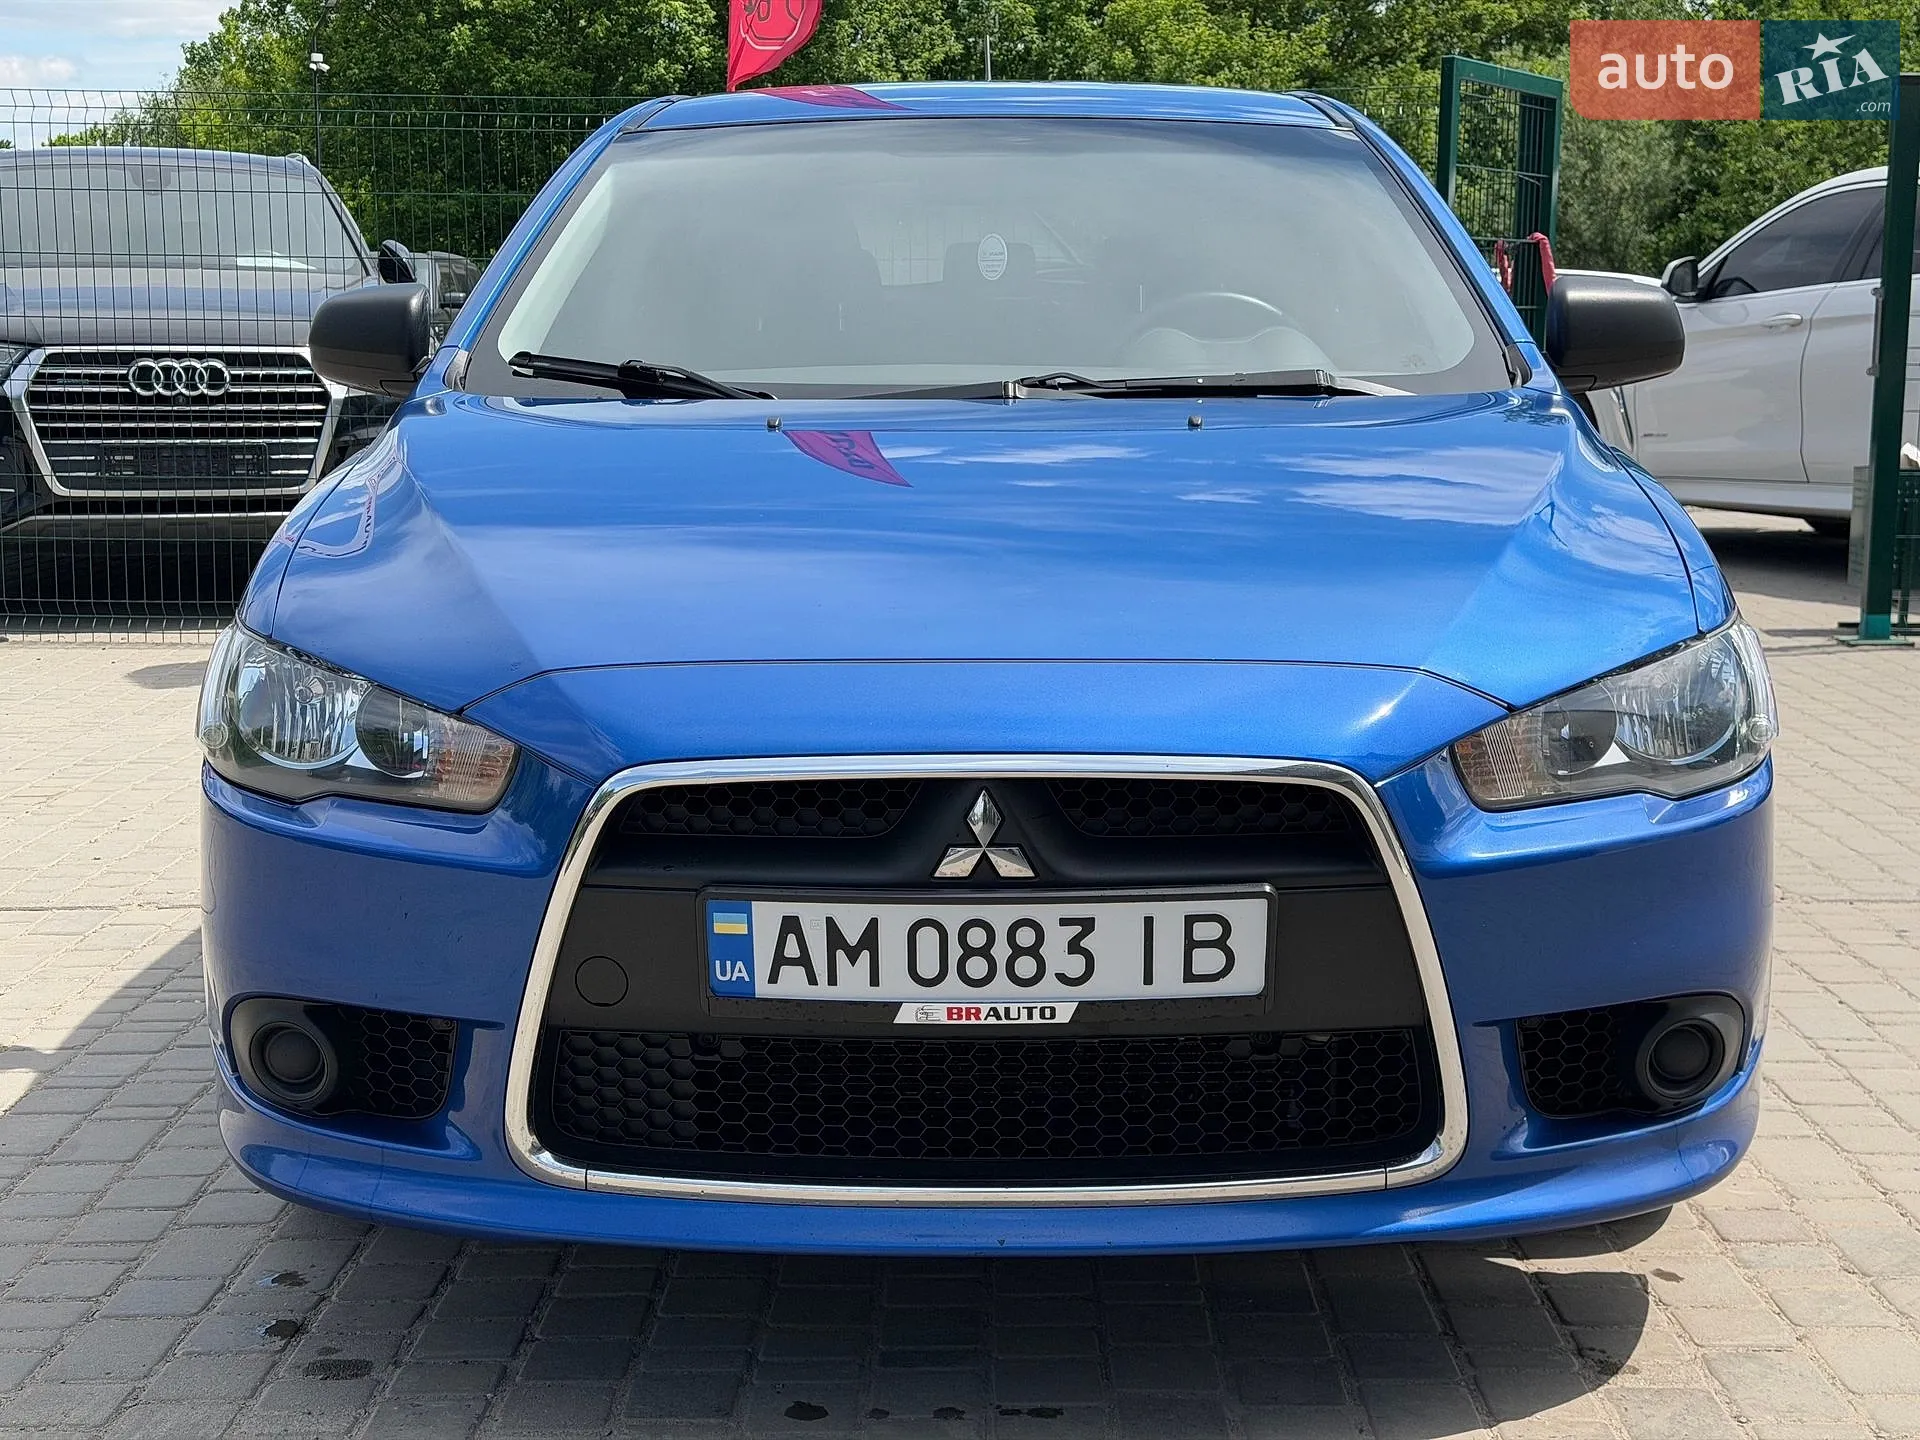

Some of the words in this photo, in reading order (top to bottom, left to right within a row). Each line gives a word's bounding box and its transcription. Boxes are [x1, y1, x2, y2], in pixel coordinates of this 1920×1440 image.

[767, 915, 880, 988] AM
[906, 916, 1096, 989] 0883
[1142, 913, 1236, 986] IB
[715, 960, 750, 982] UA
[946, 1006, 1057, 1022] BRAUTO
